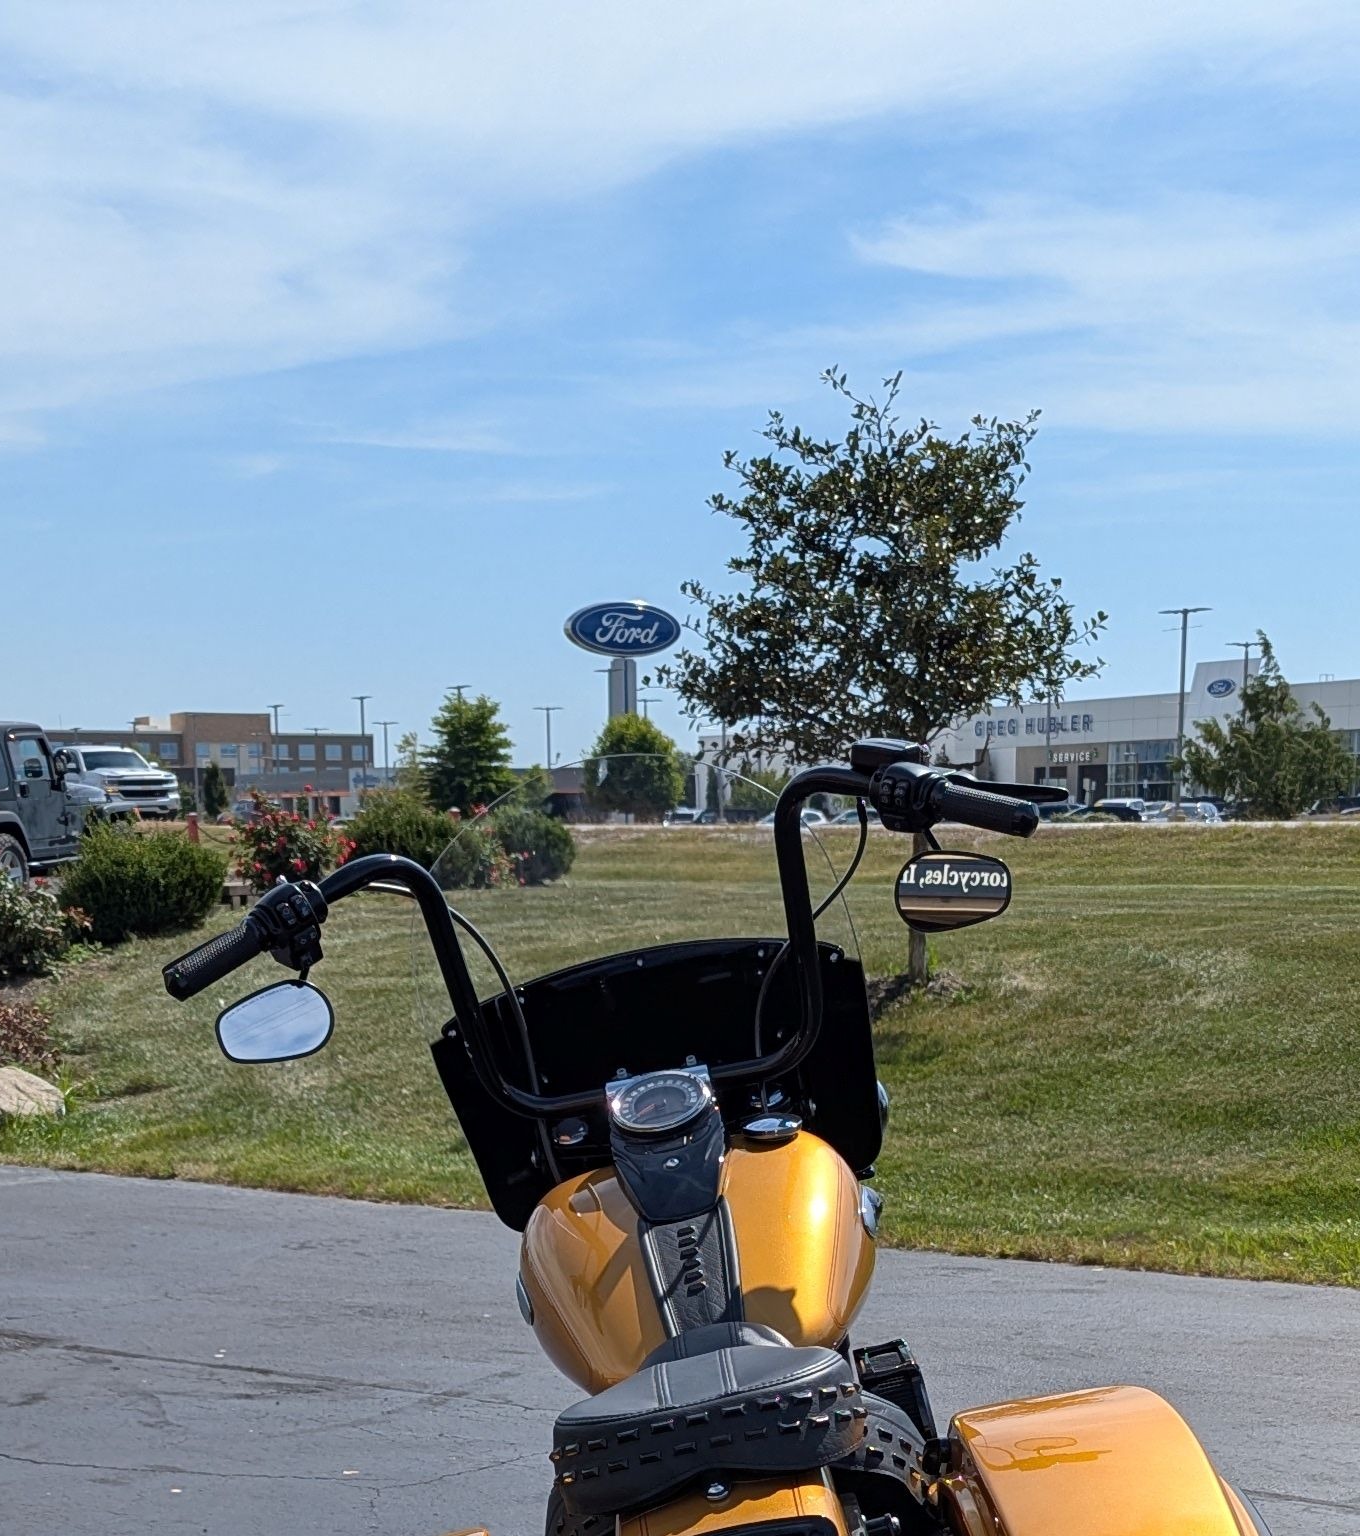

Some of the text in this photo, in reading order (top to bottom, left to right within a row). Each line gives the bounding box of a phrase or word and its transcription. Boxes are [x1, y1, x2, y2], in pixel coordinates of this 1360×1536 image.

[595, 612, 660, 644] Ford
[975, 714, 1093, 737] GREG HUBLER
[1053, 751, 1091, 763] SERVICE
